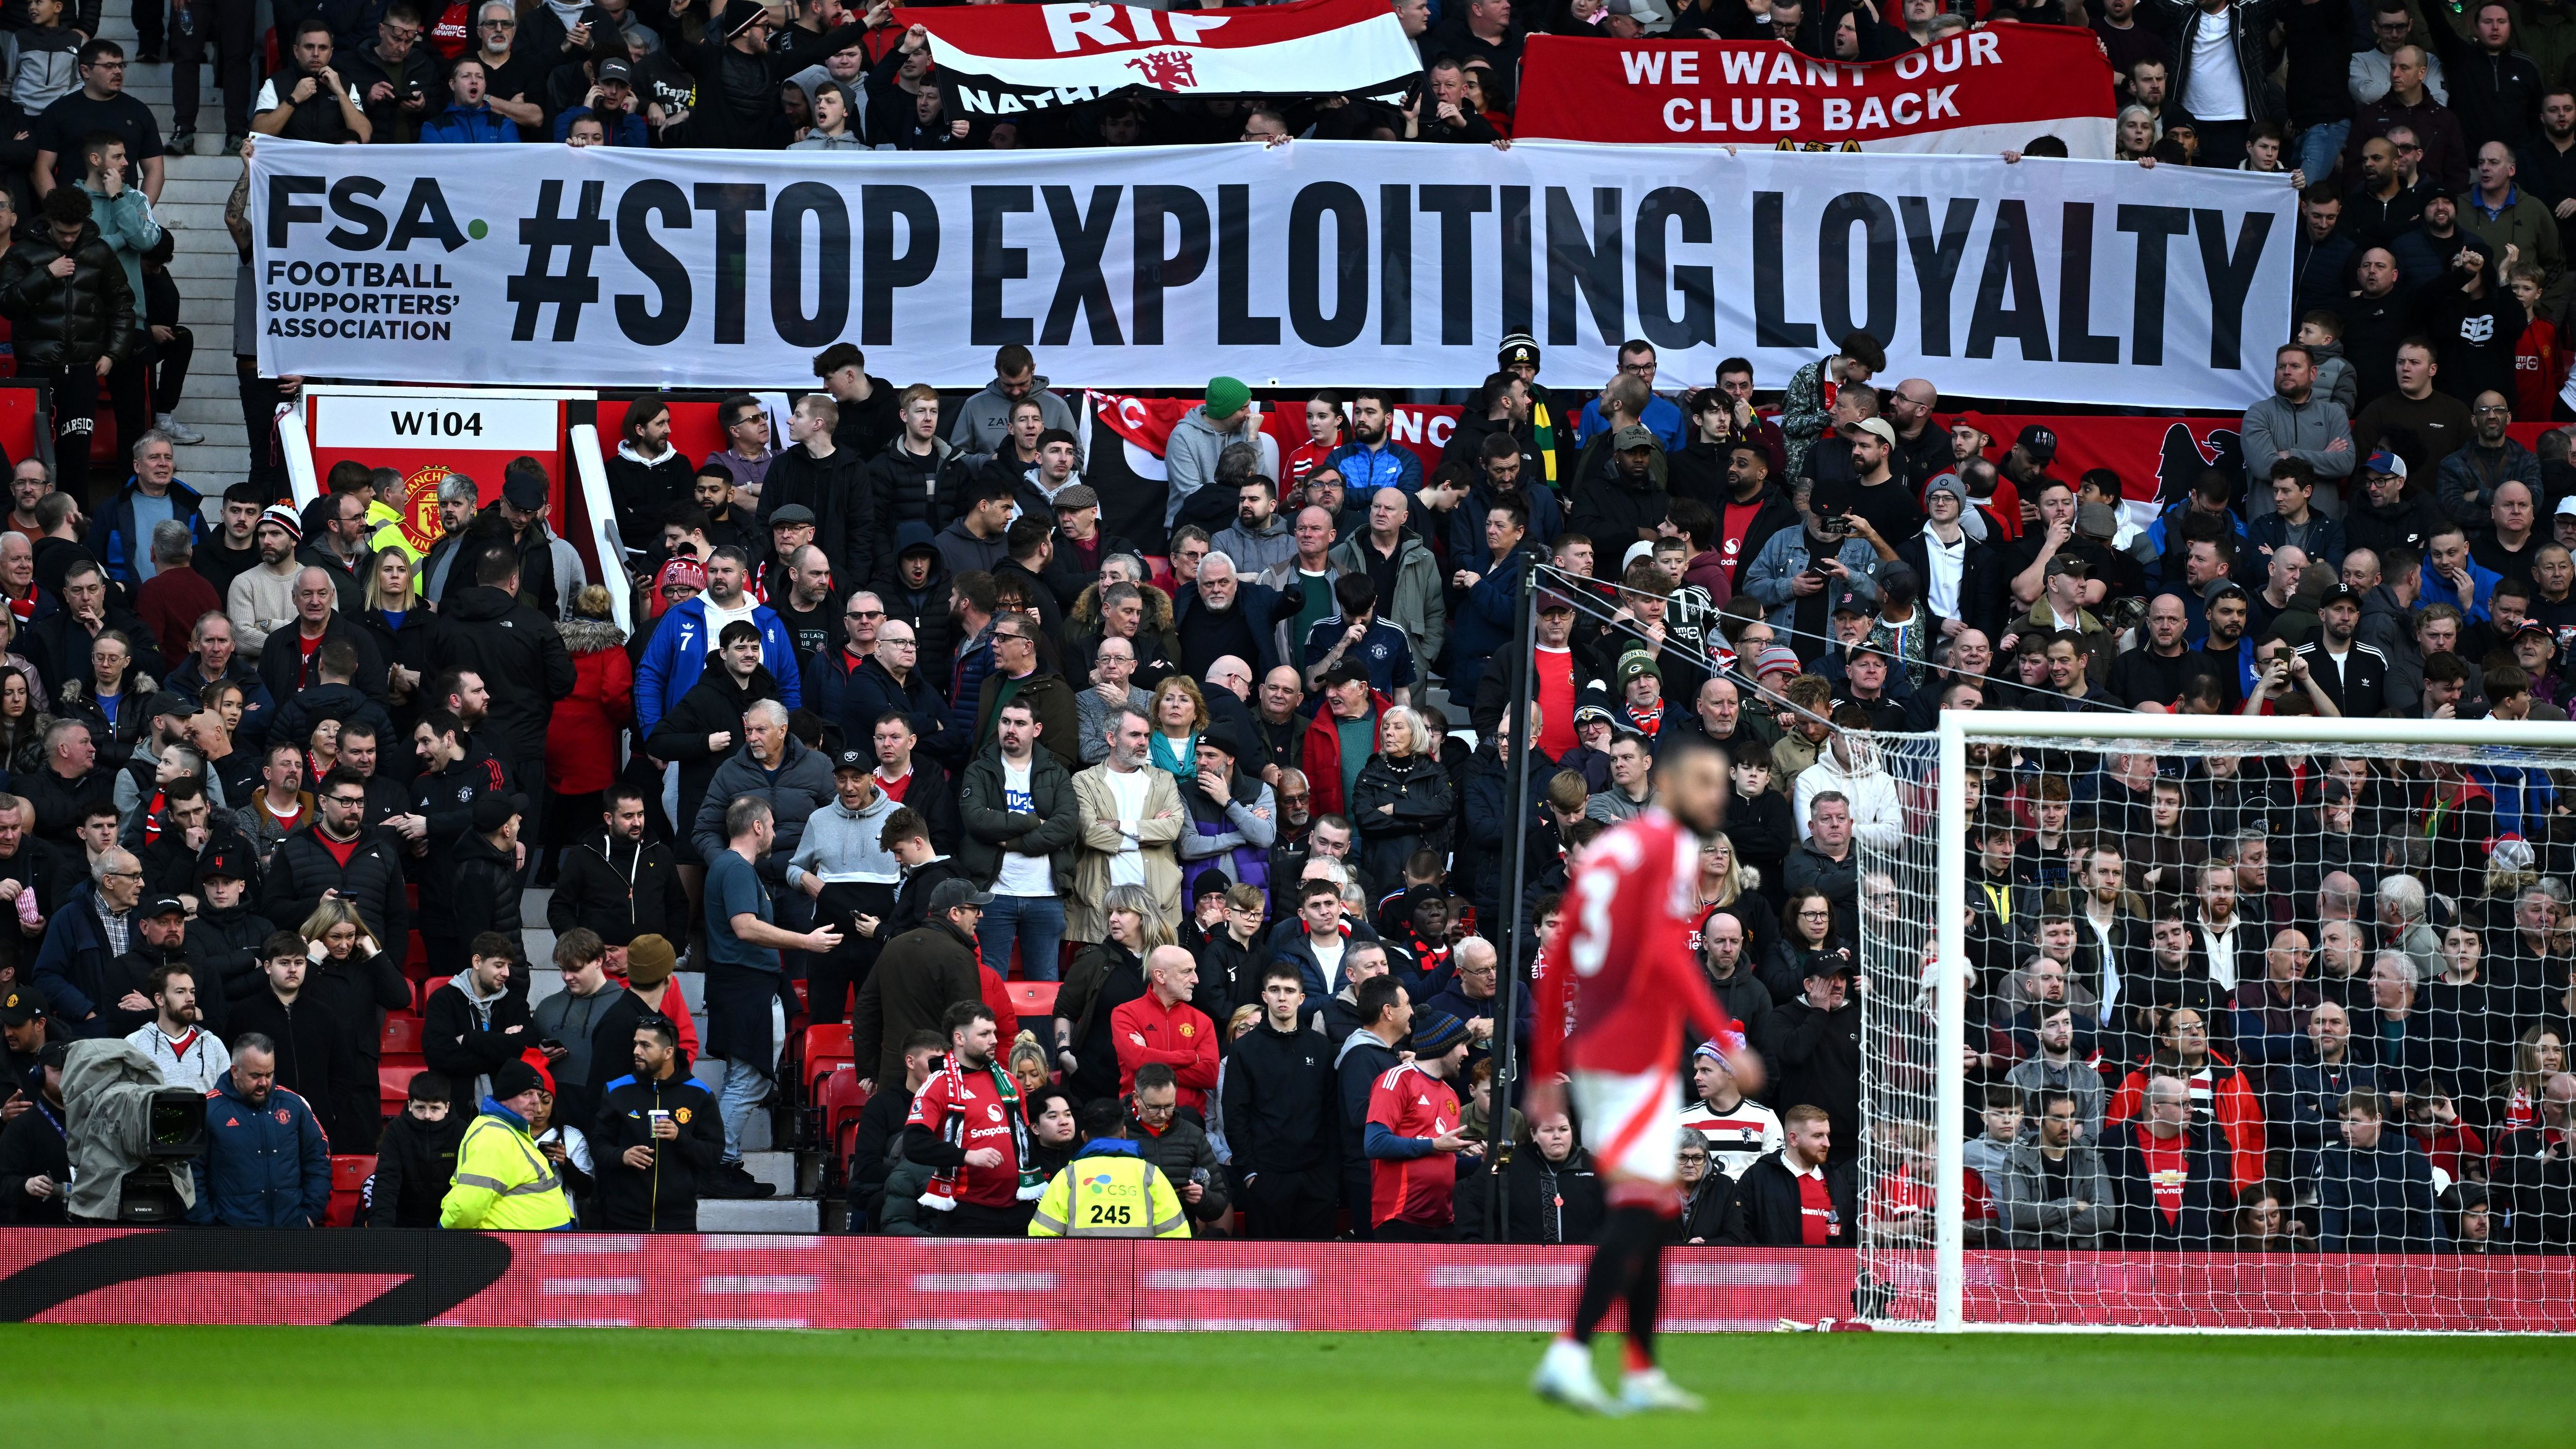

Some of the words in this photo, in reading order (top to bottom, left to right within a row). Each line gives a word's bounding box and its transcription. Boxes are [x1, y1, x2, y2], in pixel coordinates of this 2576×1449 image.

[438, 22, 458, 30] Team
[1041, 3, 1231, 53] RIP
[1621, 51, 1700, 85] WE
[1720, 50, 1872, 87] WANT
[1894, 31, 2004, 80] OUR
[958, 83, 1122, 114] NATH
[1663, 98, 1801, 132] CLUB
[1823, 83, 1961, 131] BACK
[267, 260, 452, 289] FOOTBALL
[507, 179, 941, 348] #STOP
[970, 181, 1716, 351] EXPLOITING
[1752, 190, 2275, 370] LOYALTY
[267, 291, 460, 316] SUPPORTERS'
[267, 317, 451, 341] ASSOCIATION
[391, 411, 483, 437] W104
[1842, 593, 1853, 603] B
[2339, 583, 2348, 592] B
[681, 632, 693, 651] 7
[1819, 952, 1844, 961] CRUY
[1230, 971, 1236, 982] 9
[819, 1163, 824, 1182] FF
[1107, 1184, 1137, 1196] CSG
[1090, 1205, 1131, 1225] 245
